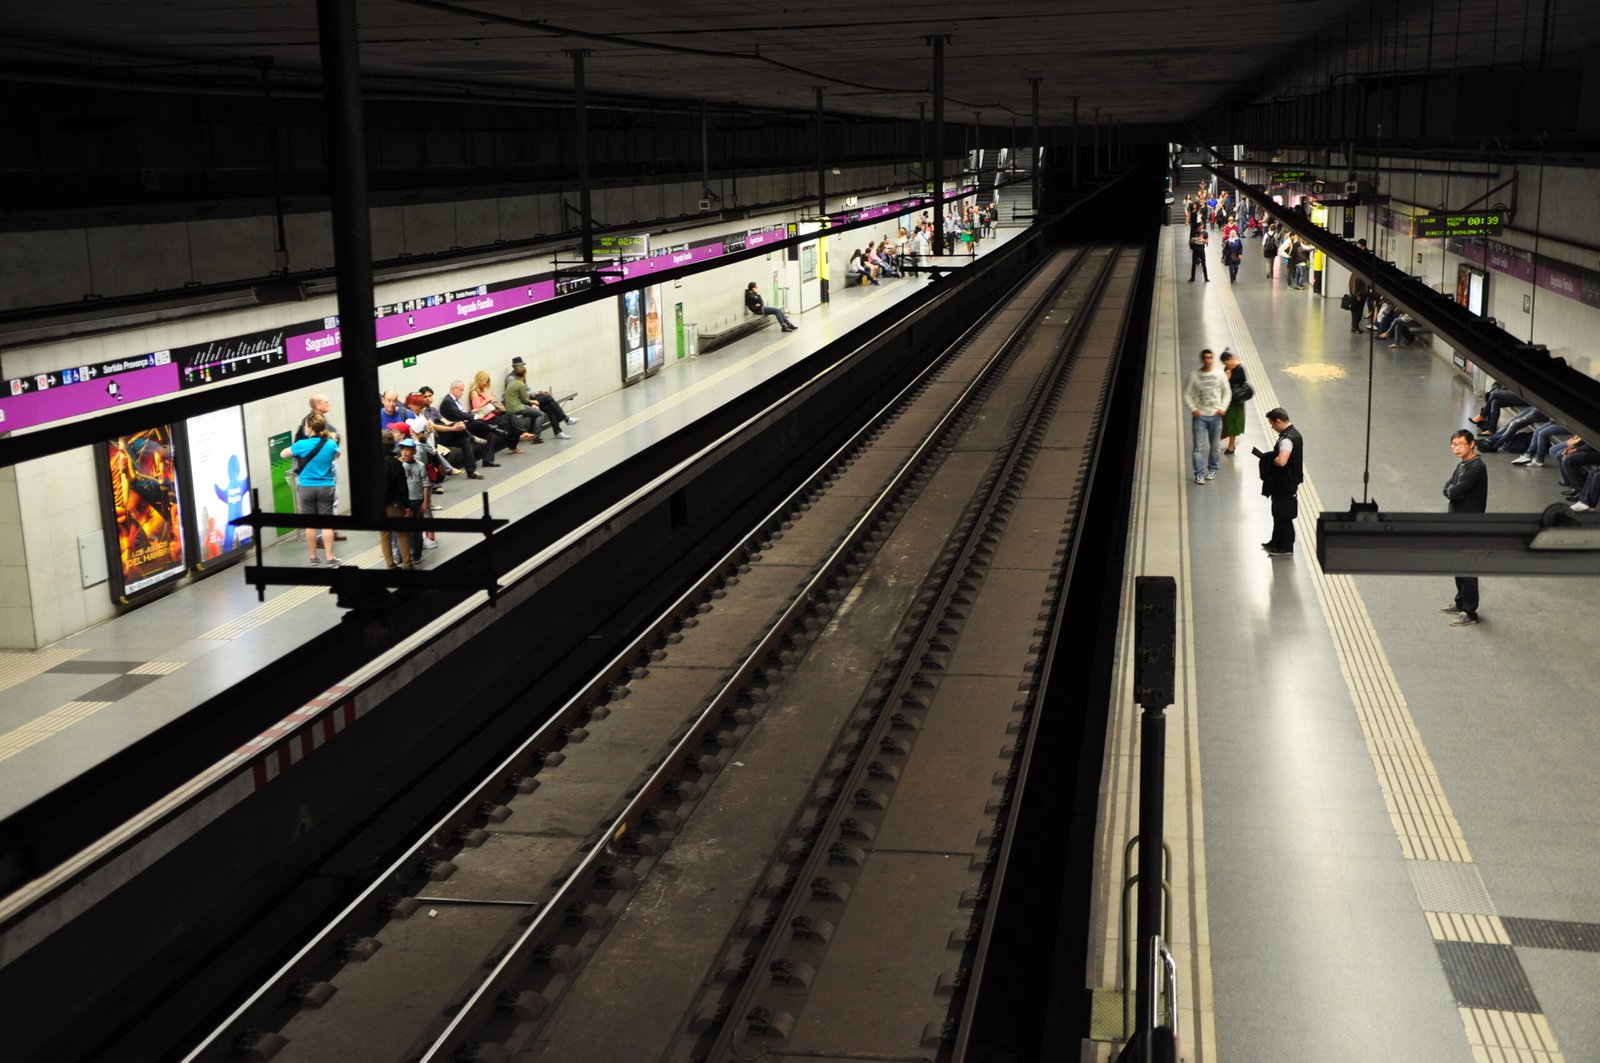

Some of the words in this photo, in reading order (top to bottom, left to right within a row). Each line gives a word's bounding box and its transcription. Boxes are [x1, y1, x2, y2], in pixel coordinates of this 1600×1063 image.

[1467, 216, 1499, 226] 00:39
[305, 334, 335, 352] Sagrada
[102, 362, 123, 374] Sortida
[123, 358, 149, 370] Provença
[131, 548, 145, 558] LOS
[144, 540, 168, 553] JUEGOS
[127, 557, 144, 568] DEL
